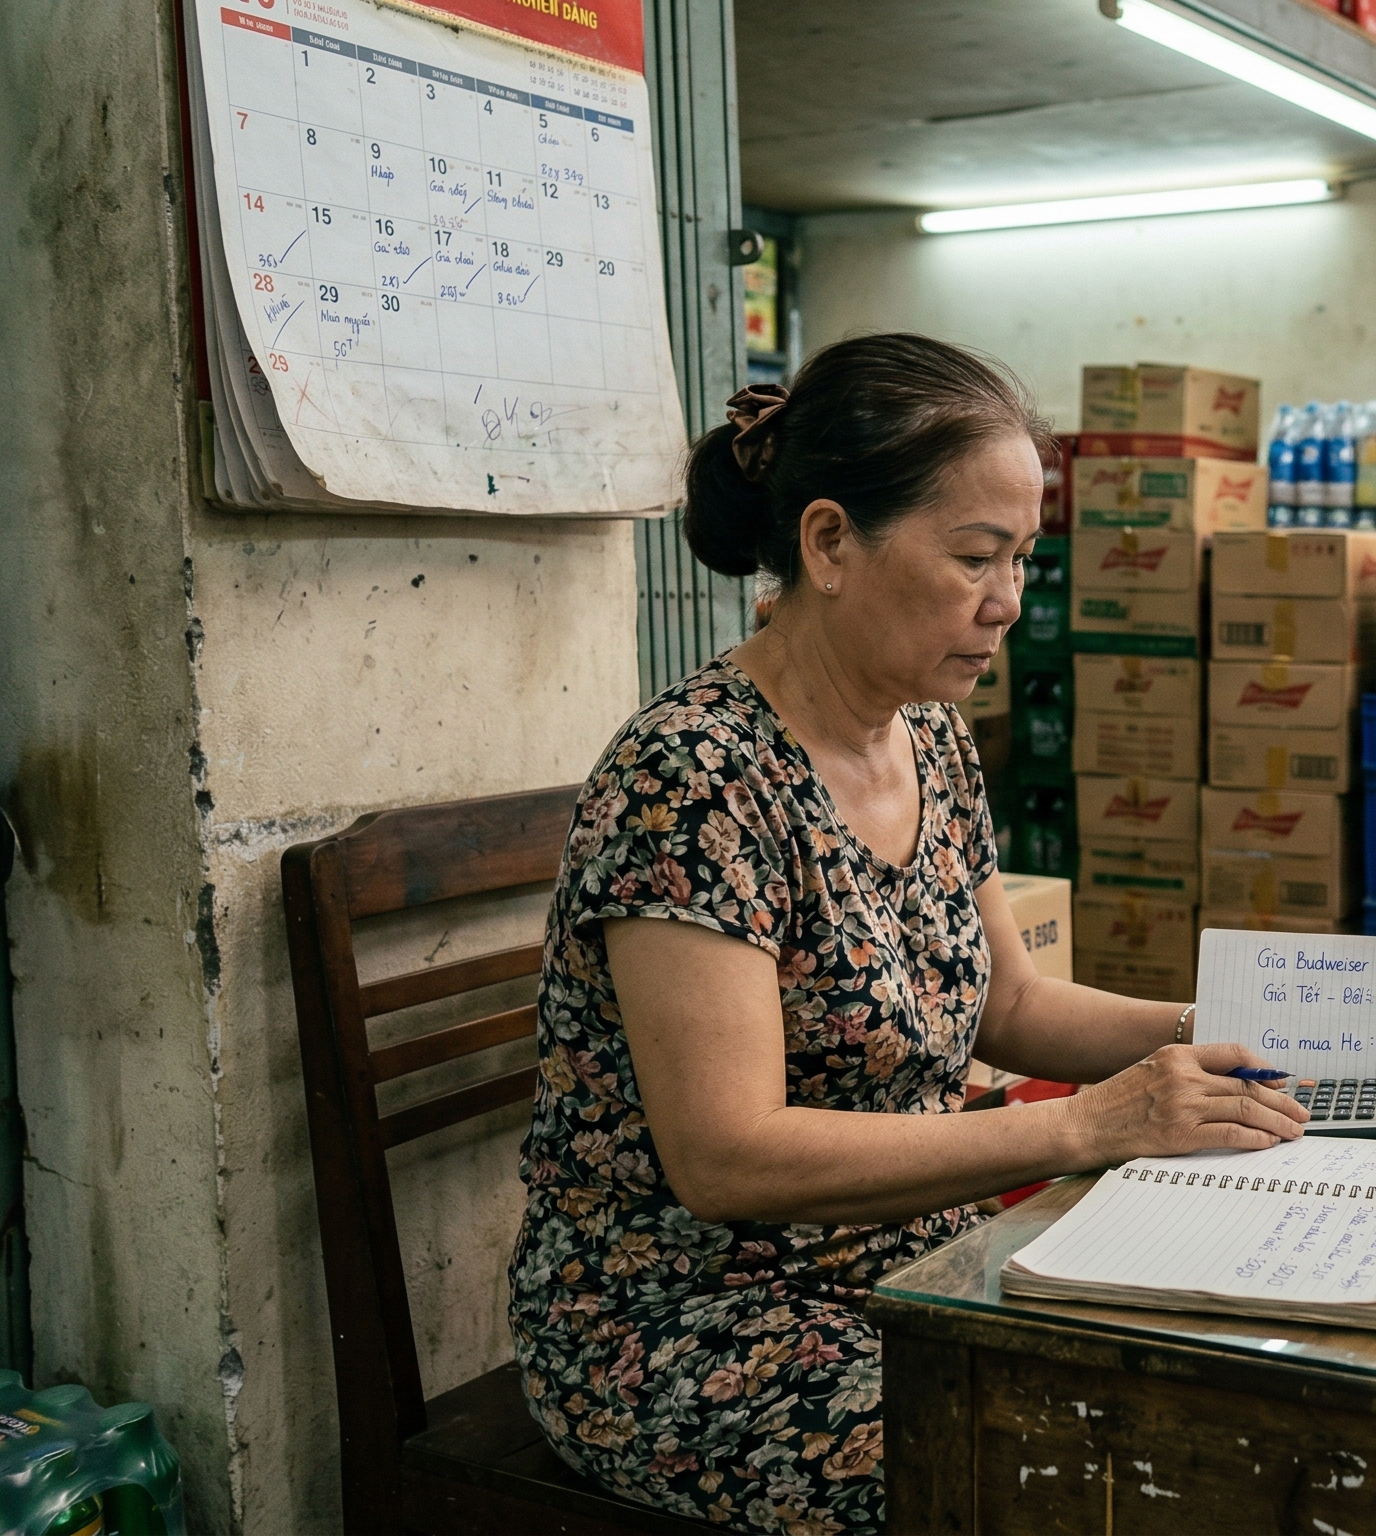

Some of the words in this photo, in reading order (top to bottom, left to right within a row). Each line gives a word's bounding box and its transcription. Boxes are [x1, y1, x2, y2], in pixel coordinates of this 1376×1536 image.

[300, 50, 309, 67] 1
[365, 67, 377, 85] 2
[425, 83, 436, 100] 3
[483, 99, 493, 115] 4
[236, 111, 249, 130] 7
[539, 114, 548, 129] 5
[306, 128, 317, 146] 8
[591, 127, 600, 142] 6
[370, 142, 381, 160] 9
[429, 156, 447, 175] 10
[486, 170, 502, 187] 11
[541, 182, 559, 199] 12
[243, 192, 265, 212] 14
[592, 193, 610, 210] 13
[311, 206, 332, 225] 15
[375, 218, 395, 237] 16
[434, 229, 452, 247] 17
[491, 241, 510, 258] 18
[546, 250, 563, 267] 29
[253, 272, 275, 293] 28
[319, 284, 339, 303] 29
[381, 293, 401, 313] 30
[1296, 950, 1369, 972] Budweiser
[1261, 1028, 1290, 1050] Gia
[1298, 1038, 1332, 1051] mua
